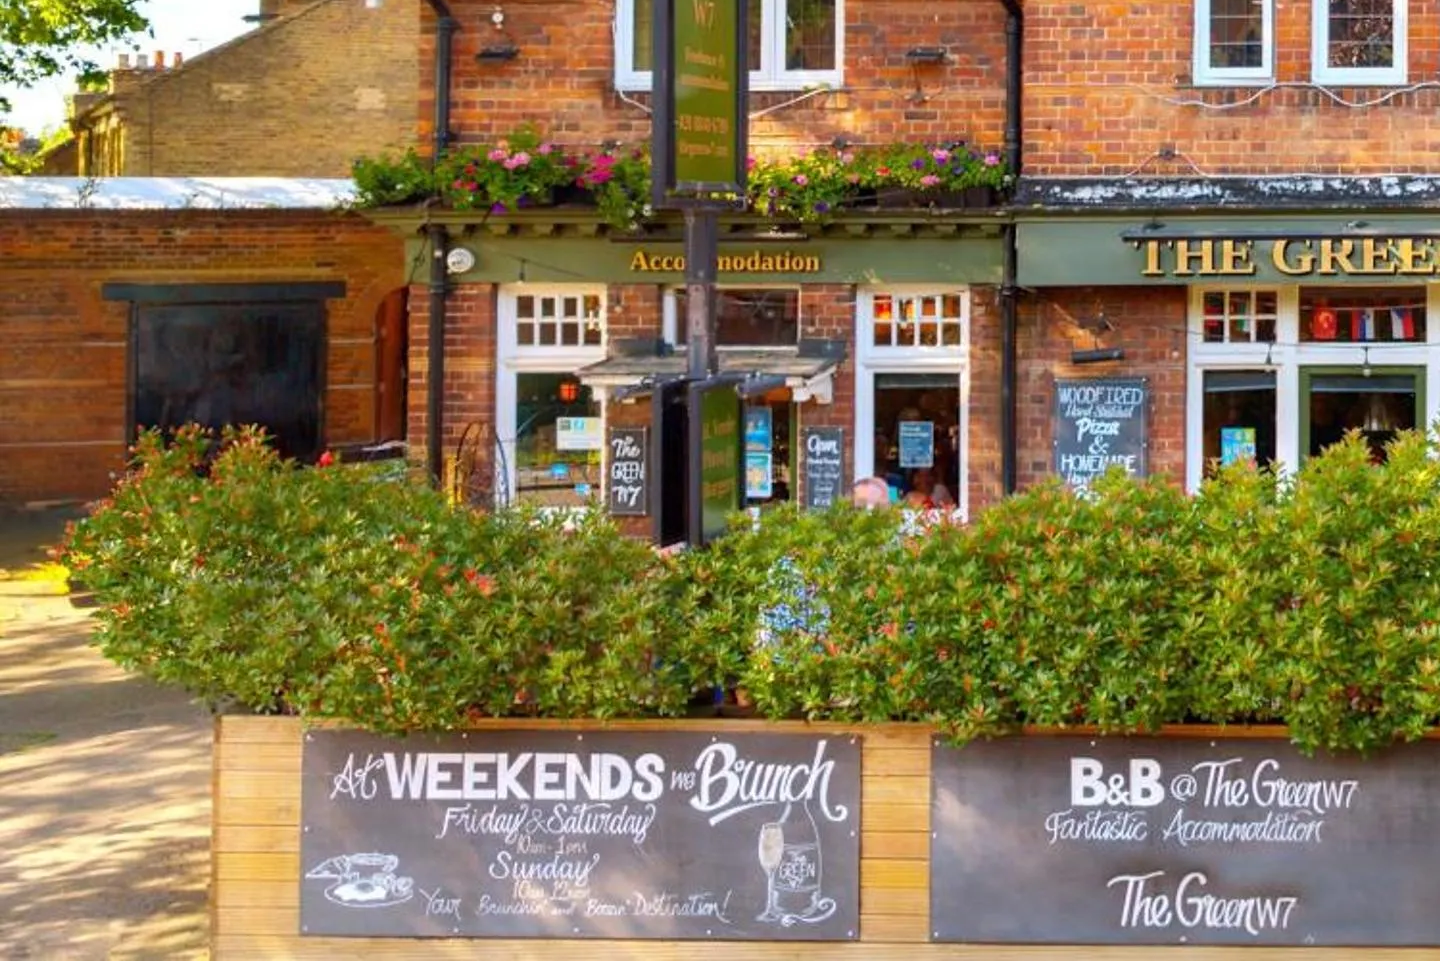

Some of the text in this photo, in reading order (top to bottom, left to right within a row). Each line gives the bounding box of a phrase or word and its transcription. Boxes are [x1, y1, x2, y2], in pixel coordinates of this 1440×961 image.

[630, 250, 821, 272] Accomodation
[1134, 237, 1256, 276] THE
[612, 436, 641, 458] The
[1075, 418, 1120, 442] Pizza
[1088, 435, 1110, 455] &
[330, 752, 384, 800] At
[384, 752, 666, 801] WEEKENDS
[690, 739, 848, 826] Brunch
[1070, 757, 1165, 807] B&B
[1170, 772, 1198, 801] @
[1192, 757, 1251, 808] The
[436, 802, 657, 844] Friday & Saturday
[1045, 809, 1148, 846] Fantastic
[488, 850, 600, 887] Sunday
[419, 888, 463, 920] Your
[1106, 870, 1173, 928] The
